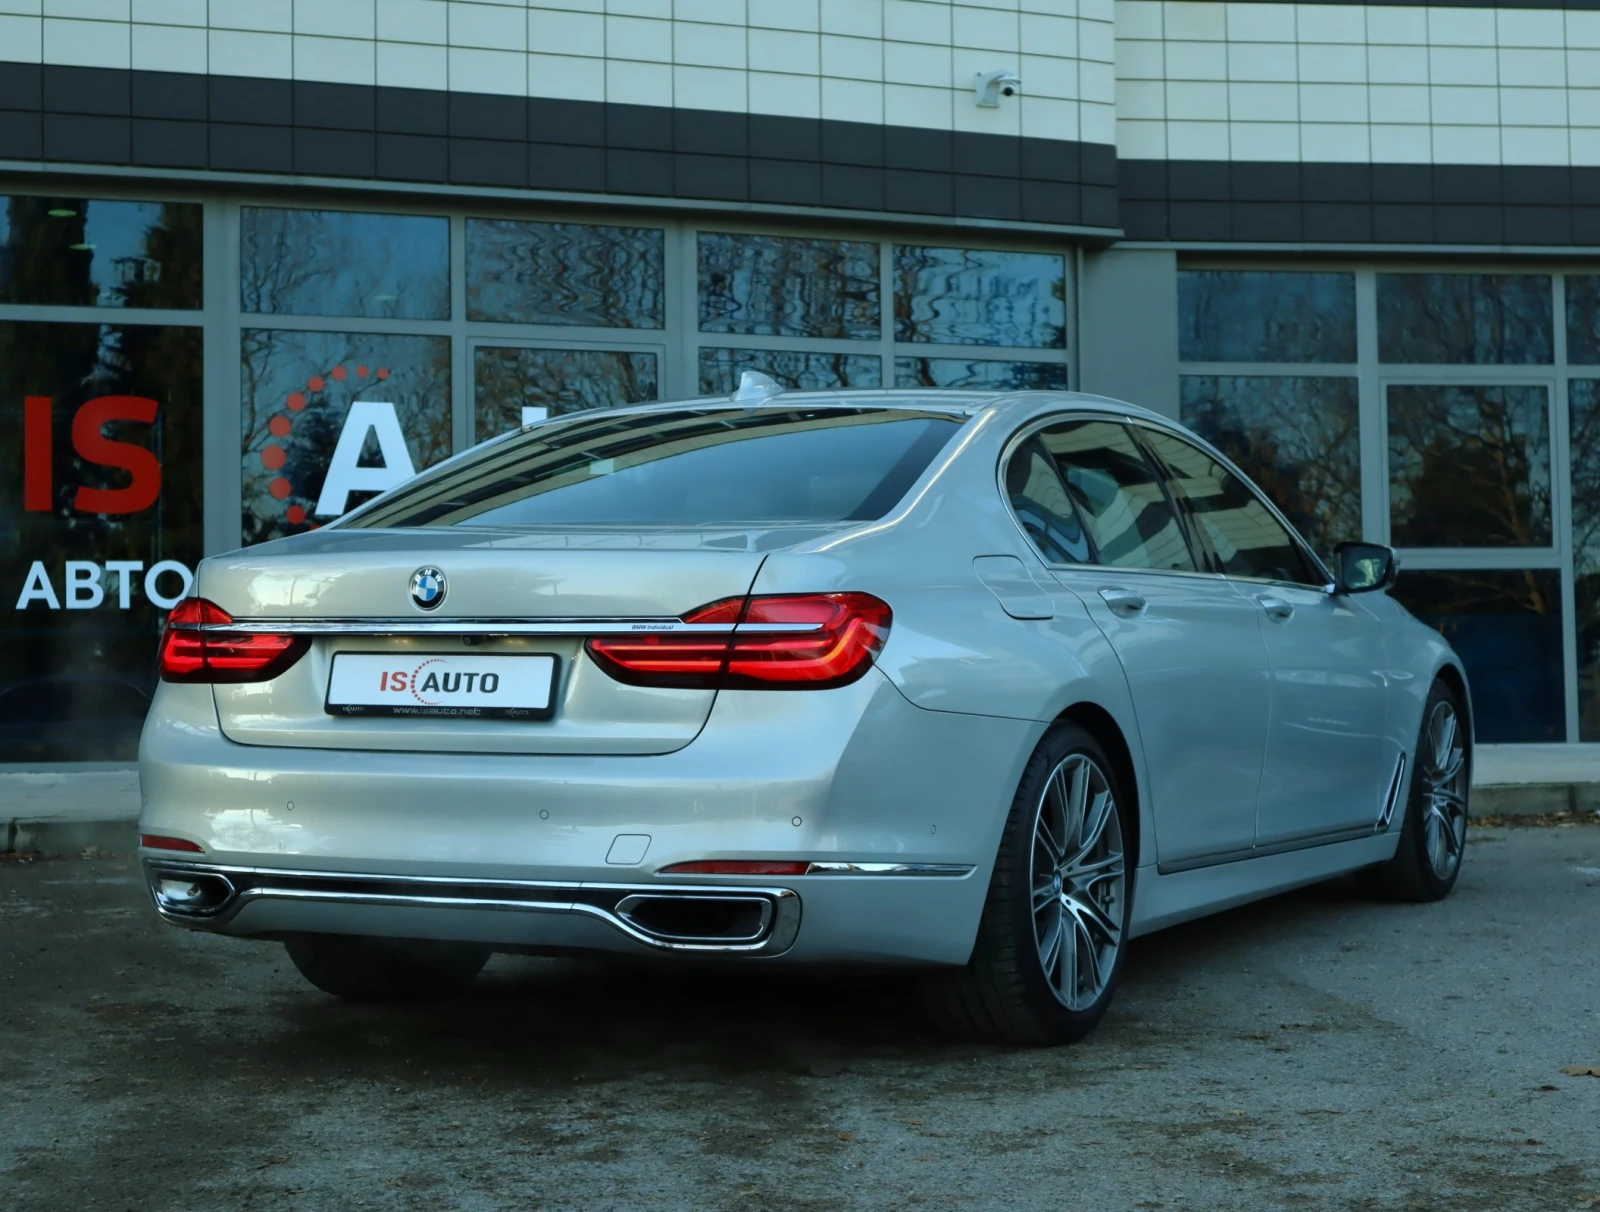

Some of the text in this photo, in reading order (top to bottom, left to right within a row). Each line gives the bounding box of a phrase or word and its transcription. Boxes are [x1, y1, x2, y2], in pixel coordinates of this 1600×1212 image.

[25, 396, 162, 514] IS
[414, 569, 443, 582] BMW
[380, 671, 499, 693] IS AUTO
[393, 706, 481, 715] www.isauto.net
